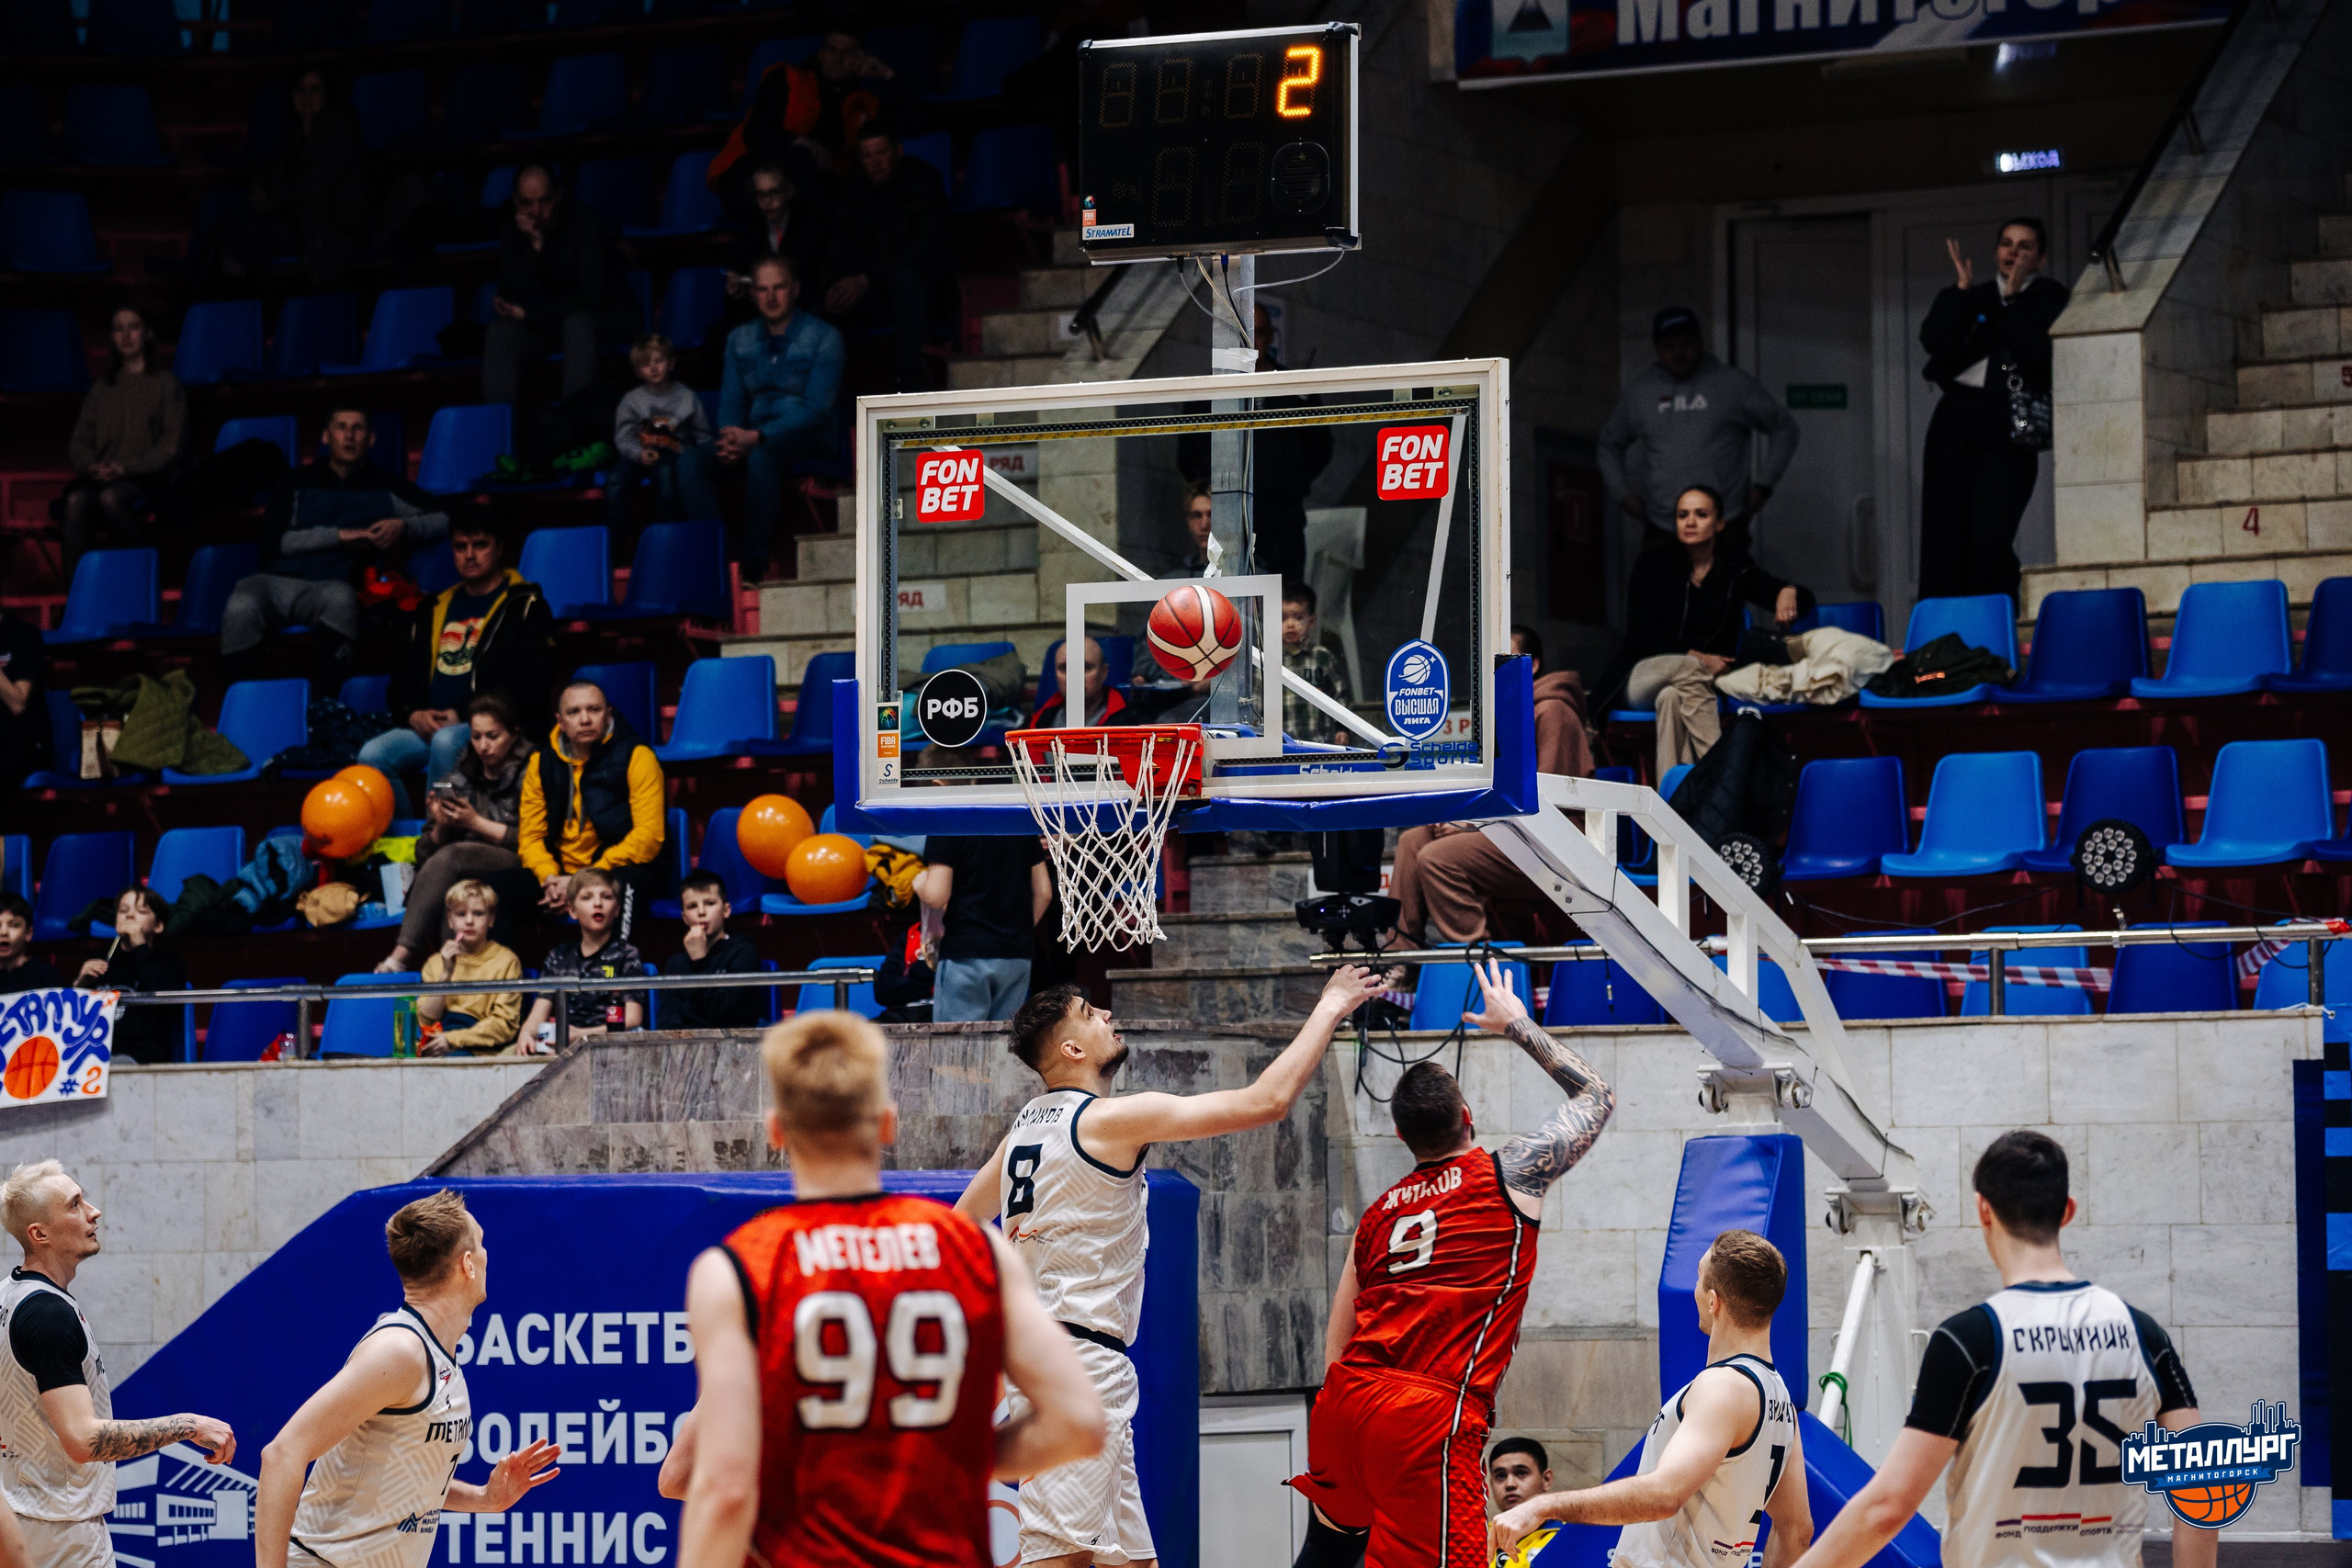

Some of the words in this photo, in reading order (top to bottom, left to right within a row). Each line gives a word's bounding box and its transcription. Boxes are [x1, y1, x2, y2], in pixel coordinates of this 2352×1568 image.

[1277, 44, 1321, 118] 2
[1085, 226, 1132, 239] STRAMATEL
[1381, 434, 1444, 462] FON
[920, 457, 979, 486] FON
[1381, 461, 1444, 491] BET
[920, 484, 979, 513] BET
[2243, 506, 2260, 536] 4
[898, 591, 923, 608] ЯД
[1398, 686, 1435, 696] FONBET
[926, 696, 979, 720] РФБ
[1395, 698, 1440, 716] ВЫСШАЯ
[880, 736, 896, 745] FIBA
[1442, 719, 1453, 735] 3
[1410, 740, 1479, 753] Schelde
[1410, 754, 1478, 769] Sports
[1005, 1143, 1044, 1219] 8
[1387, 1209, 1439, 1275] 9
[794, 1290, 969, 1430] 99
[2012, 1378, 2138, 1488] 35
[439, 1511, 668, 1564] ТЕННИС
